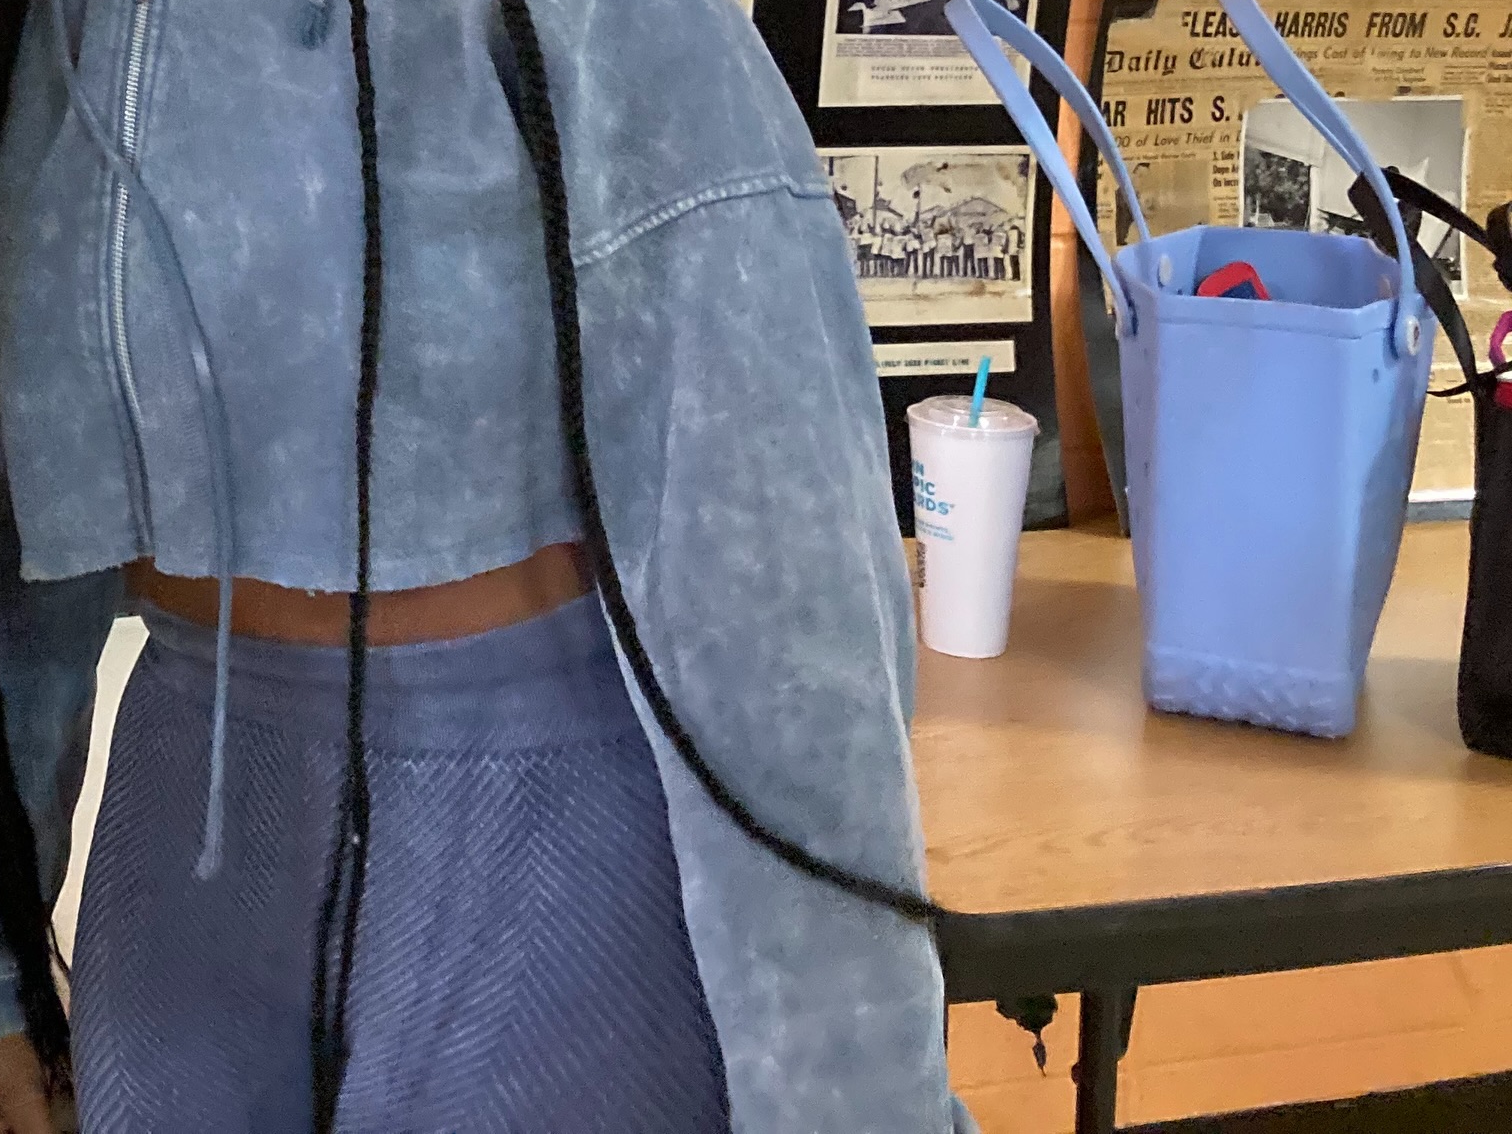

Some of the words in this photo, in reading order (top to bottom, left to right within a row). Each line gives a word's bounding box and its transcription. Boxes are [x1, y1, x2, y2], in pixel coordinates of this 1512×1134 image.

[1274, 11, 1350, 38] HARRIS
[1365, 12, 1429, 38] FROM
[1106, 49, 1178, 76] Daily
[1189, 47, 1262, 70] Calu
[1146, 96, 1194, 126] HITS
[1154, 134, 1180, 147] Love
[1185, 130, 1215, 145] Thief
